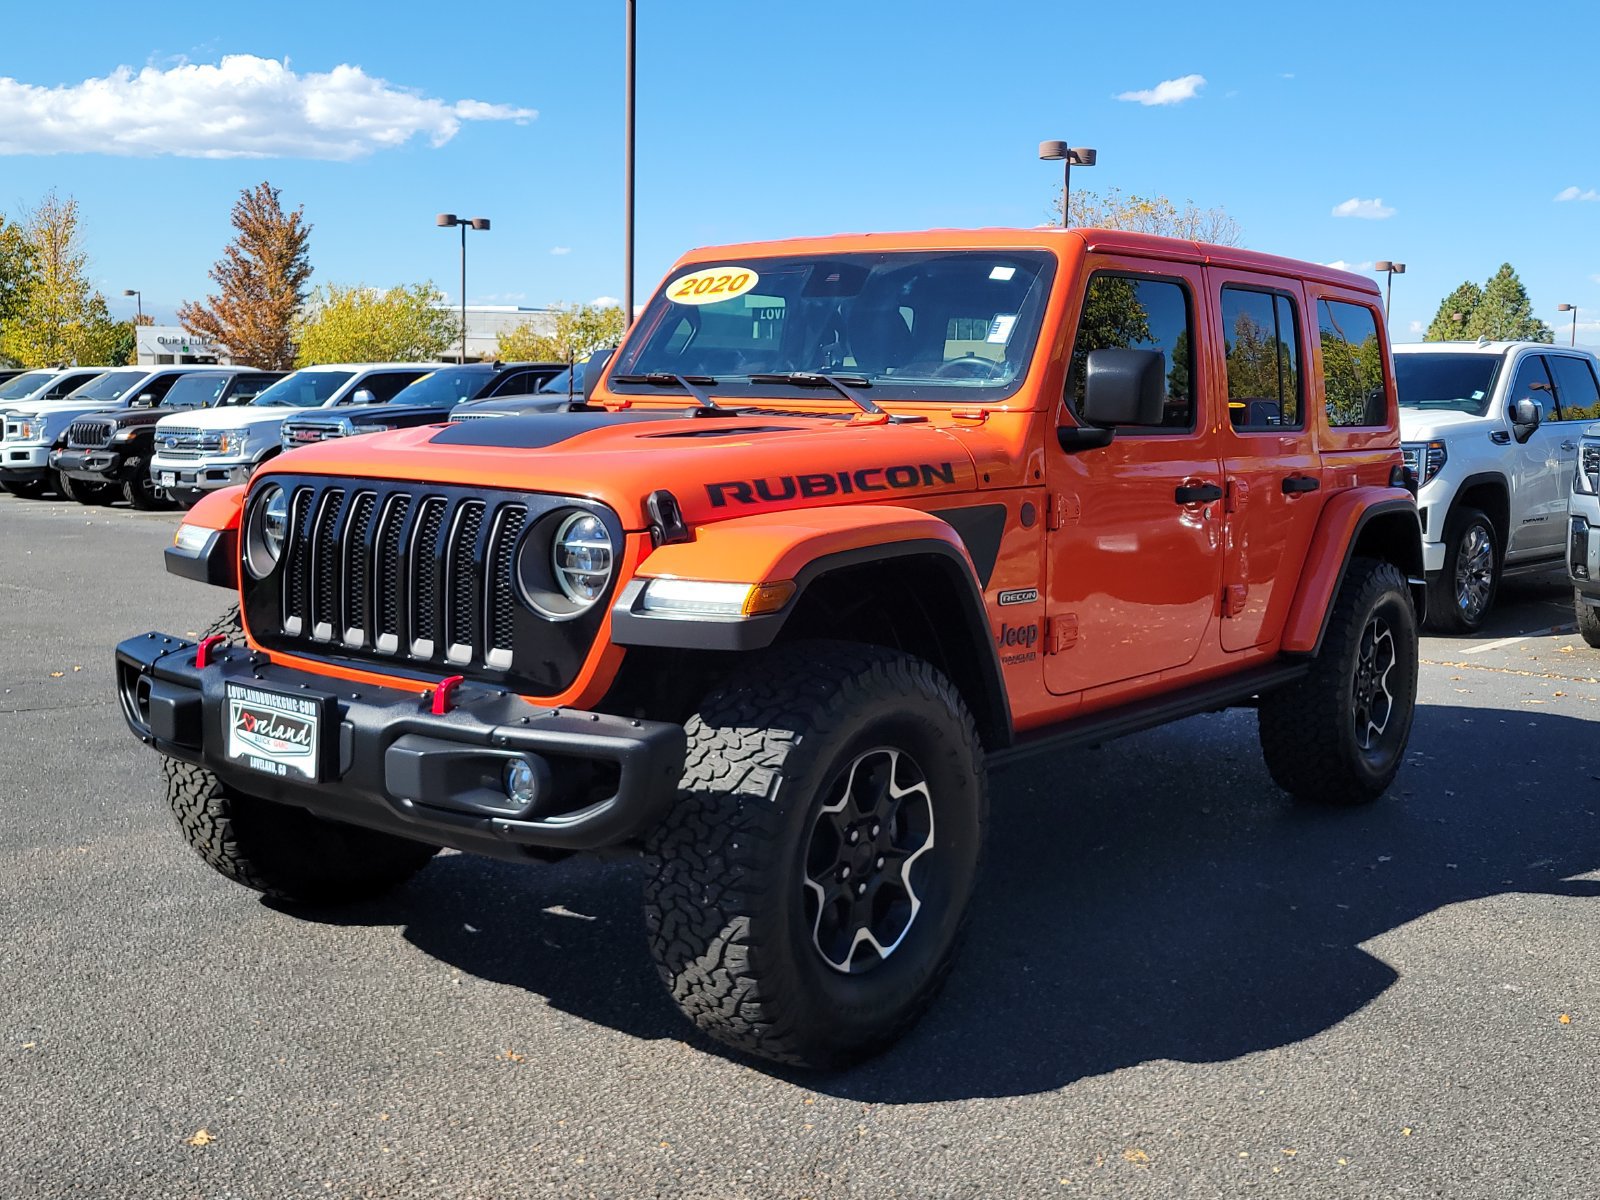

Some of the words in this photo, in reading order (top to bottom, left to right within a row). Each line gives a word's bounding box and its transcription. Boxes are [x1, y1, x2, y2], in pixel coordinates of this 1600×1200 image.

[674, 273, 750, 297] 2020
[157, 336, 186, 345] Quick
[295, 431, 320, 440] GMC
[704, 462, 955, 508] RUBICON
[1003, 592, 1036, 602] RECON
[998, 623, 1039, 648] Jeep
[254, 735, 271, 745] BUICK
[273, 741, 289, 750] GMC
[250, 756, 277, 774] LOVELAND,
[277, 764, 287, 776] CO
